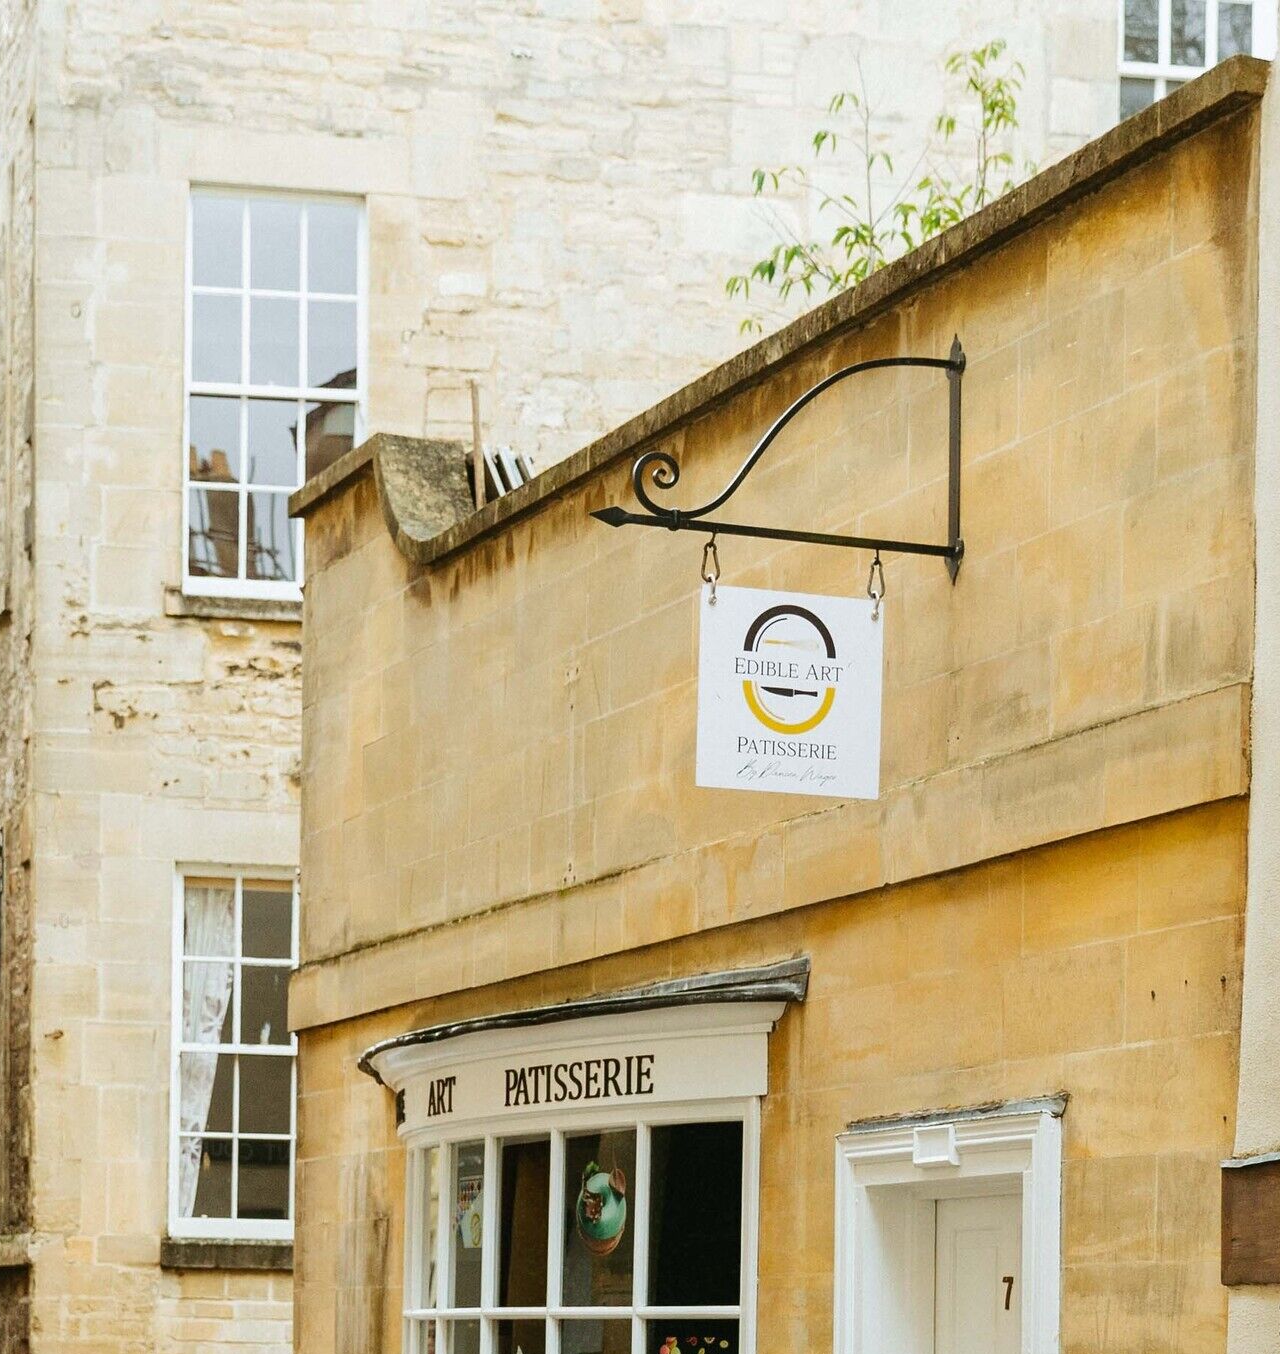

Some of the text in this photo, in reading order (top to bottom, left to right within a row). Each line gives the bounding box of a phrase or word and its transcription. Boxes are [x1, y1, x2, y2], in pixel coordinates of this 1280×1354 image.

[734, 656, 844, 683] EDIBLE ART
[736, 736, 837, 760] PATISSERIE
[427, 1075, 457, 1117] ART
[504, 1054, 655, 1107] PATISSERIE
[1002, 1276, 1014, 1310] 7
